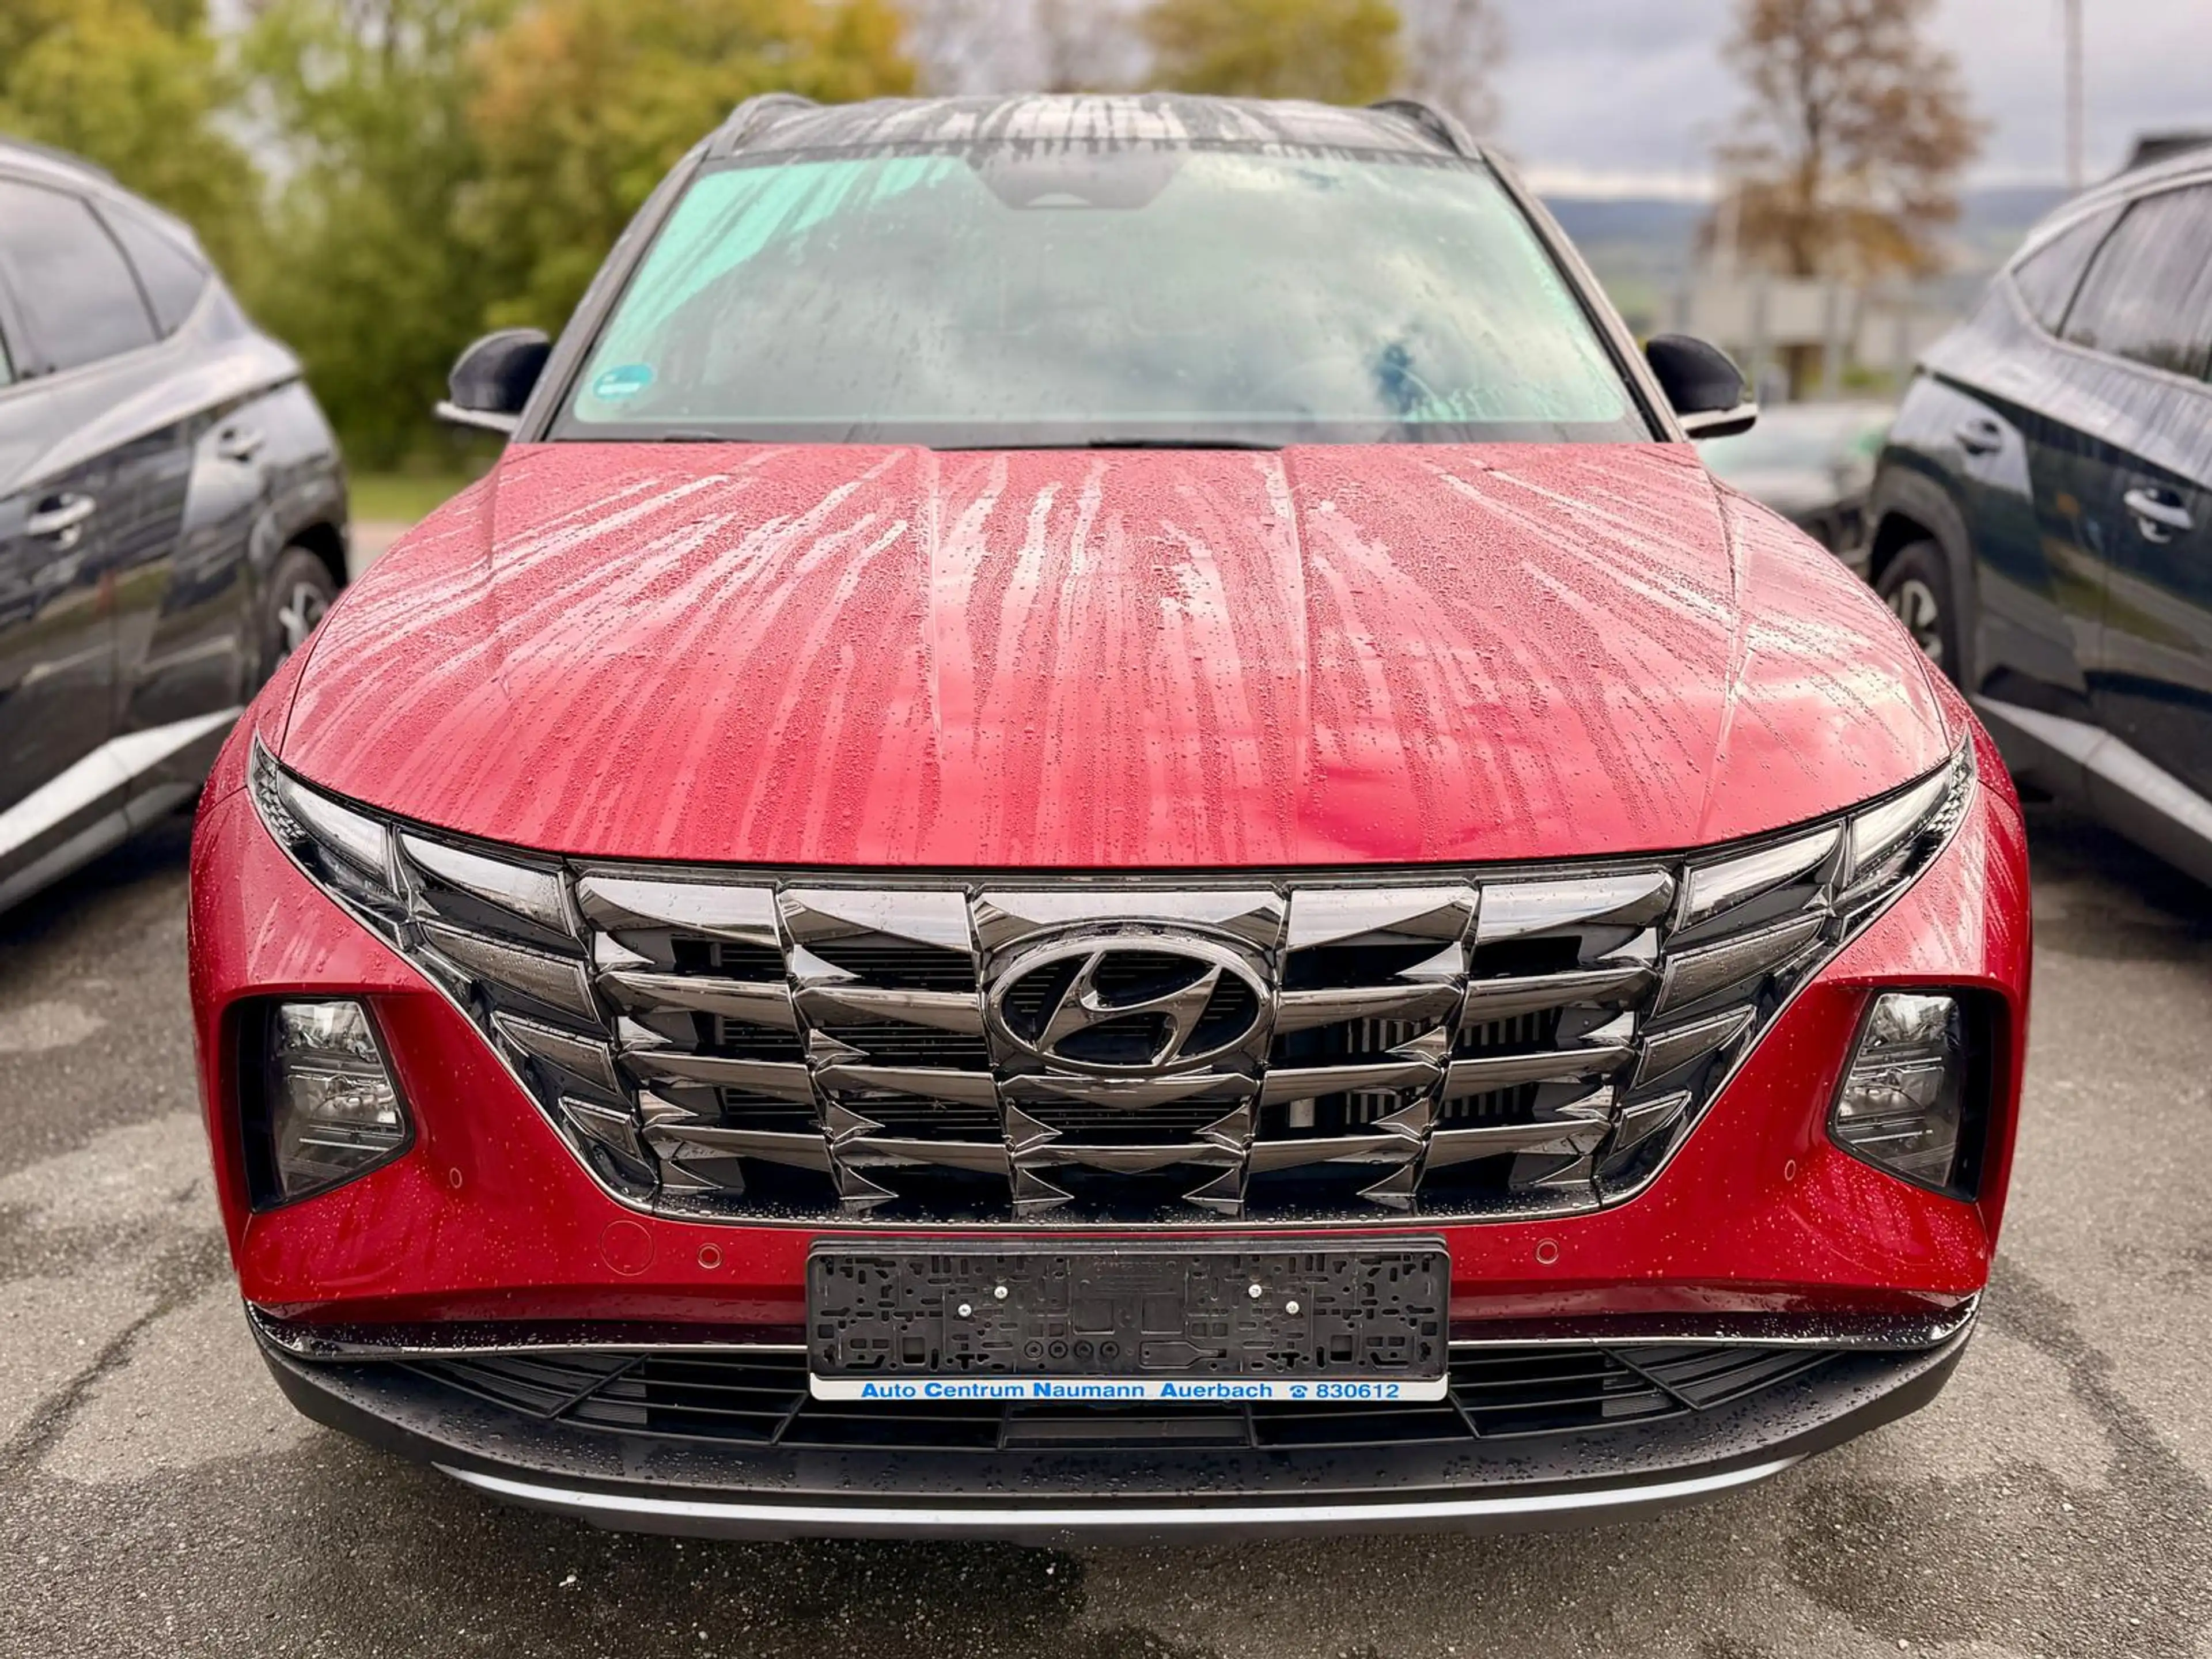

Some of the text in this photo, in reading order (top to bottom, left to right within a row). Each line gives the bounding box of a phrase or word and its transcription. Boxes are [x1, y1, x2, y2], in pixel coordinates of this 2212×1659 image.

[861, 1382, 1399, 1399] Auto Centrum Naumann Auerbach 830612
